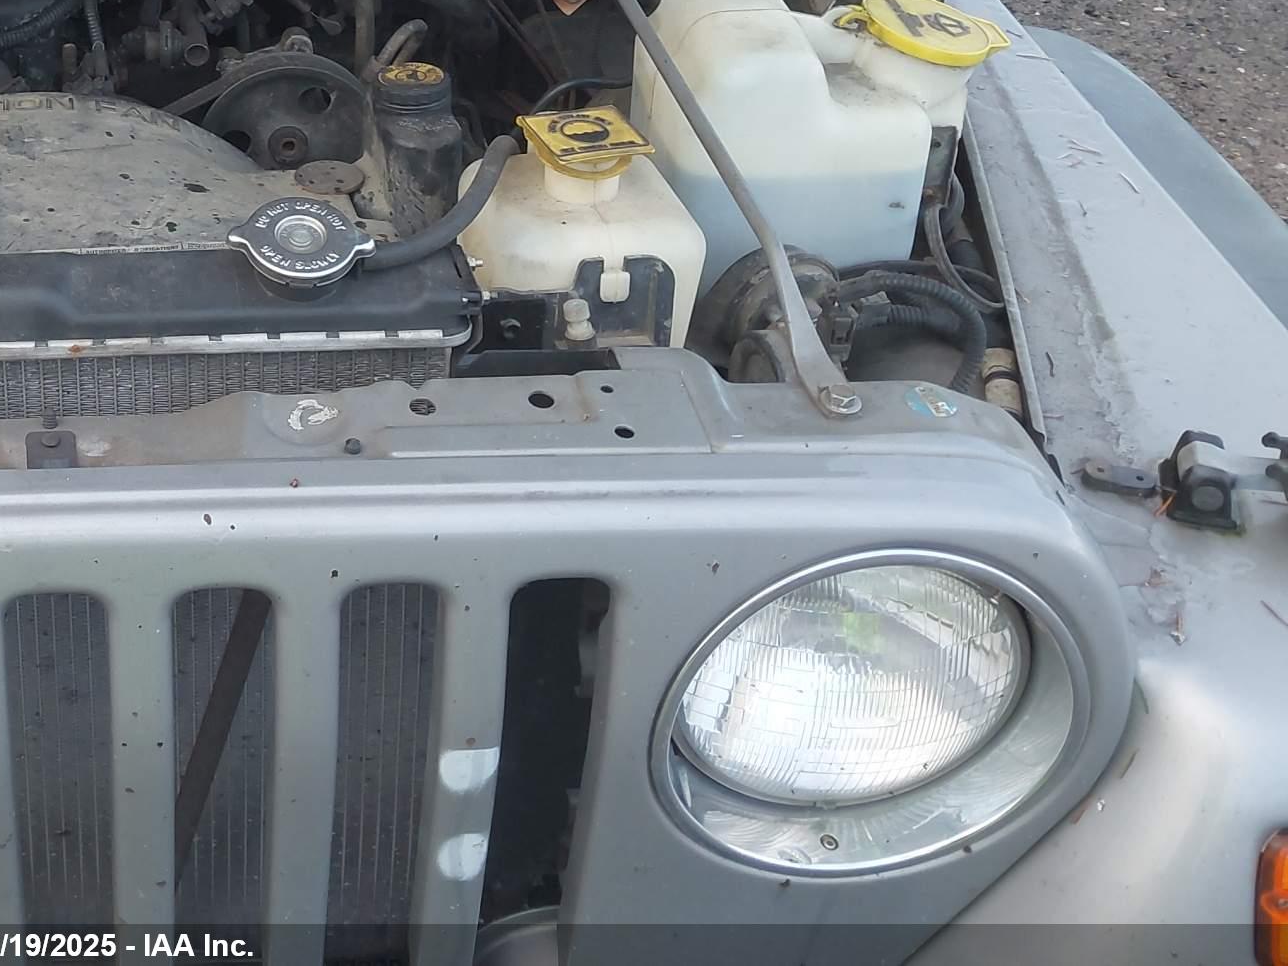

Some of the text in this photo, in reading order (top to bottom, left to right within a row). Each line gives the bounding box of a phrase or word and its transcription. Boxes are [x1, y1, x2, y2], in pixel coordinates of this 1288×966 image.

[94, 98, 181, 132] FAN
[295, 202, 328, 216] OPEN
[260, 245, 341, 270] OPEN SLOWLY
